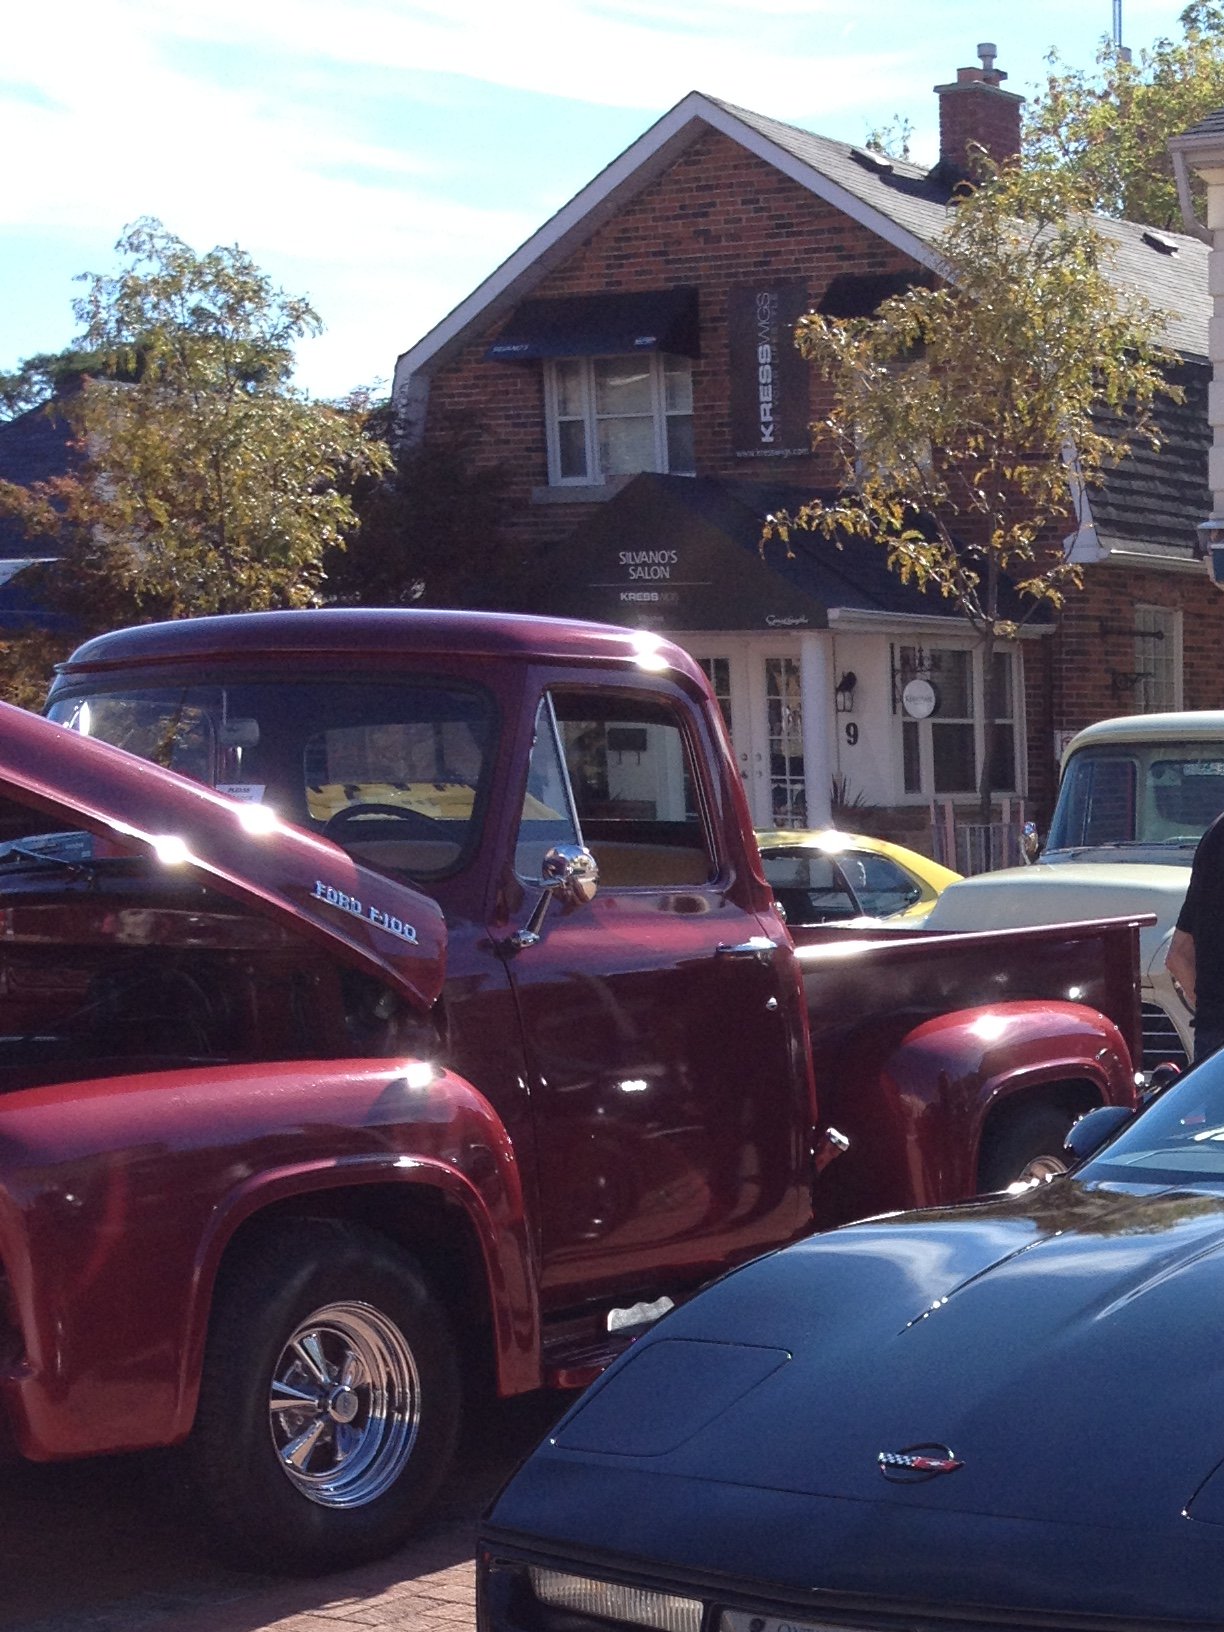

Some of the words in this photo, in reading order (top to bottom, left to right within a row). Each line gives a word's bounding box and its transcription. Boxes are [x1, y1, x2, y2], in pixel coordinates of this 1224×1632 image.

[618, 550, 678, 565] SILVANO'S
[628, 565, 671, 580] SALON
[845, 722, 859, 746] 9
[314, 880, 362, 913] FORD
